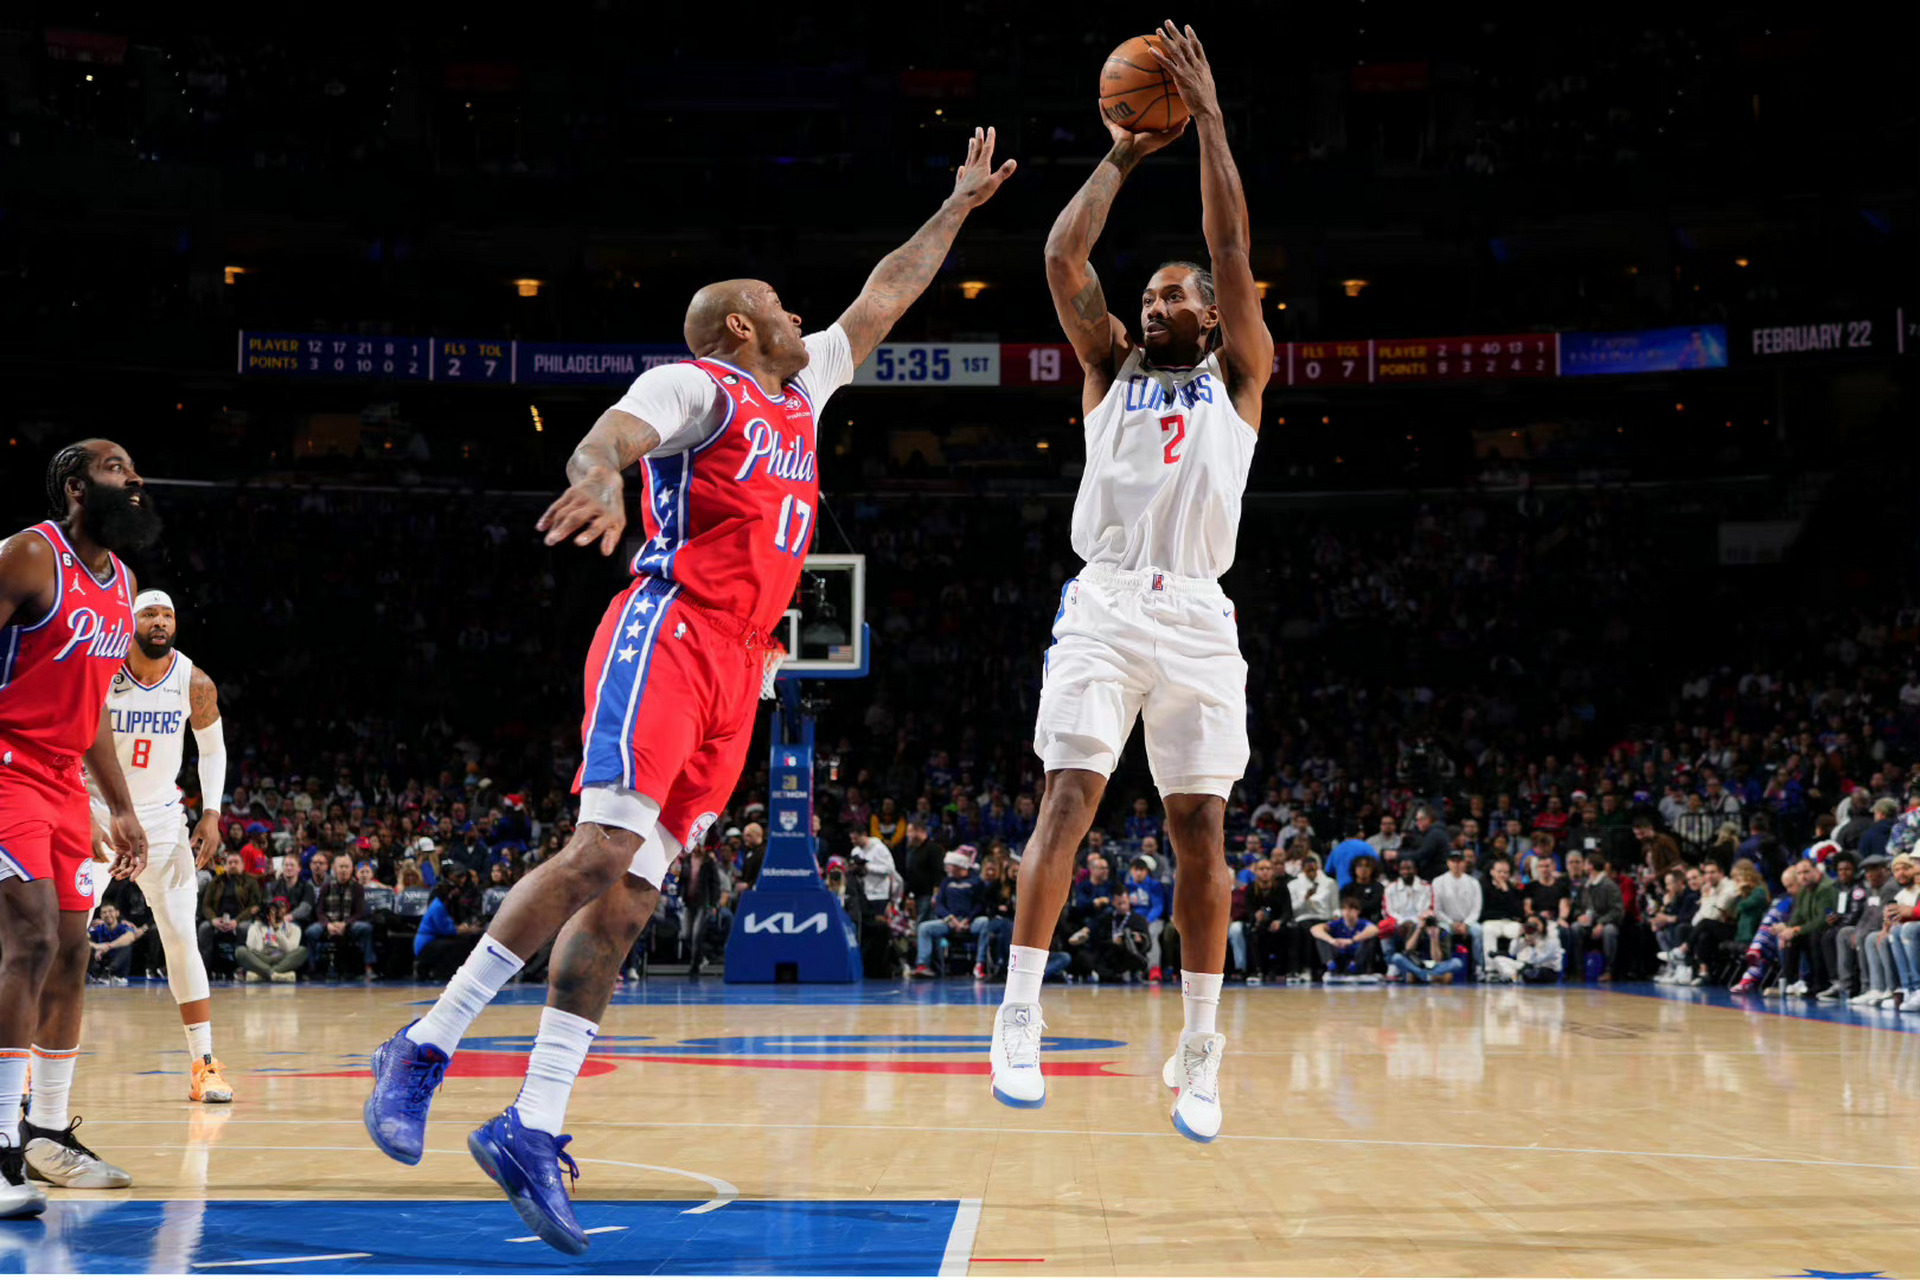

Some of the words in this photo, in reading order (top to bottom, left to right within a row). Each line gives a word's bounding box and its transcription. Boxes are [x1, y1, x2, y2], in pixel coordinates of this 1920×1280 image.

[249, 338, 299, 353] PLAYER
[308, 340, 322, 353] 12
[333, 342, 346, 354] 17
[356, 342, 373, 355] 21
[1752, 323, 1842, 354] FEBRUARY
[1847, 321, 1872, 347] 22
[444, 344, 466, 356] FLS
[478, 344, 502, 357] TOL
[1379, 345, 1428, 359] PLAYER
[1481, 341, 1501, 355] 40
[249, 356, 298, 370] POINTS
[309, 357, 319, 371] 3
[333, 358, 345, 372] 0
[356, 358, 372, 373] 10
[383, 359, 394, 373] 0
[408, 361, 418, 374] 2
[448, 359, 460, 376] 2
[484, 360, 497, 377] 7
[534, 353, 635, 374] PHILADELPHIA
[876, 348, 950, 381] 5:35
[962, 357, 990, 372] 1ST
[1028, 348, 1061, 381] 19
[1305, 361, 1321, 379] 0
[1341, 361, 1355, 378] 7
[1379, 362, 1428, 376] POINTS
[1485, 359, 1496, 373] 2
[735, 418, 815, 481] Phila
[1160, 414, 1185, 464] 2
[774, 493, 812, 558] 17
[62, 552, 73, 568] 6
[54, 607, 131, 661] Phila
[110, 709, 183, 734] CLIPPERS
[132, 739, 151, 768] 8
[771, 791, 808, 799] BETMGM
[744, 912, 828, 934] KIA
